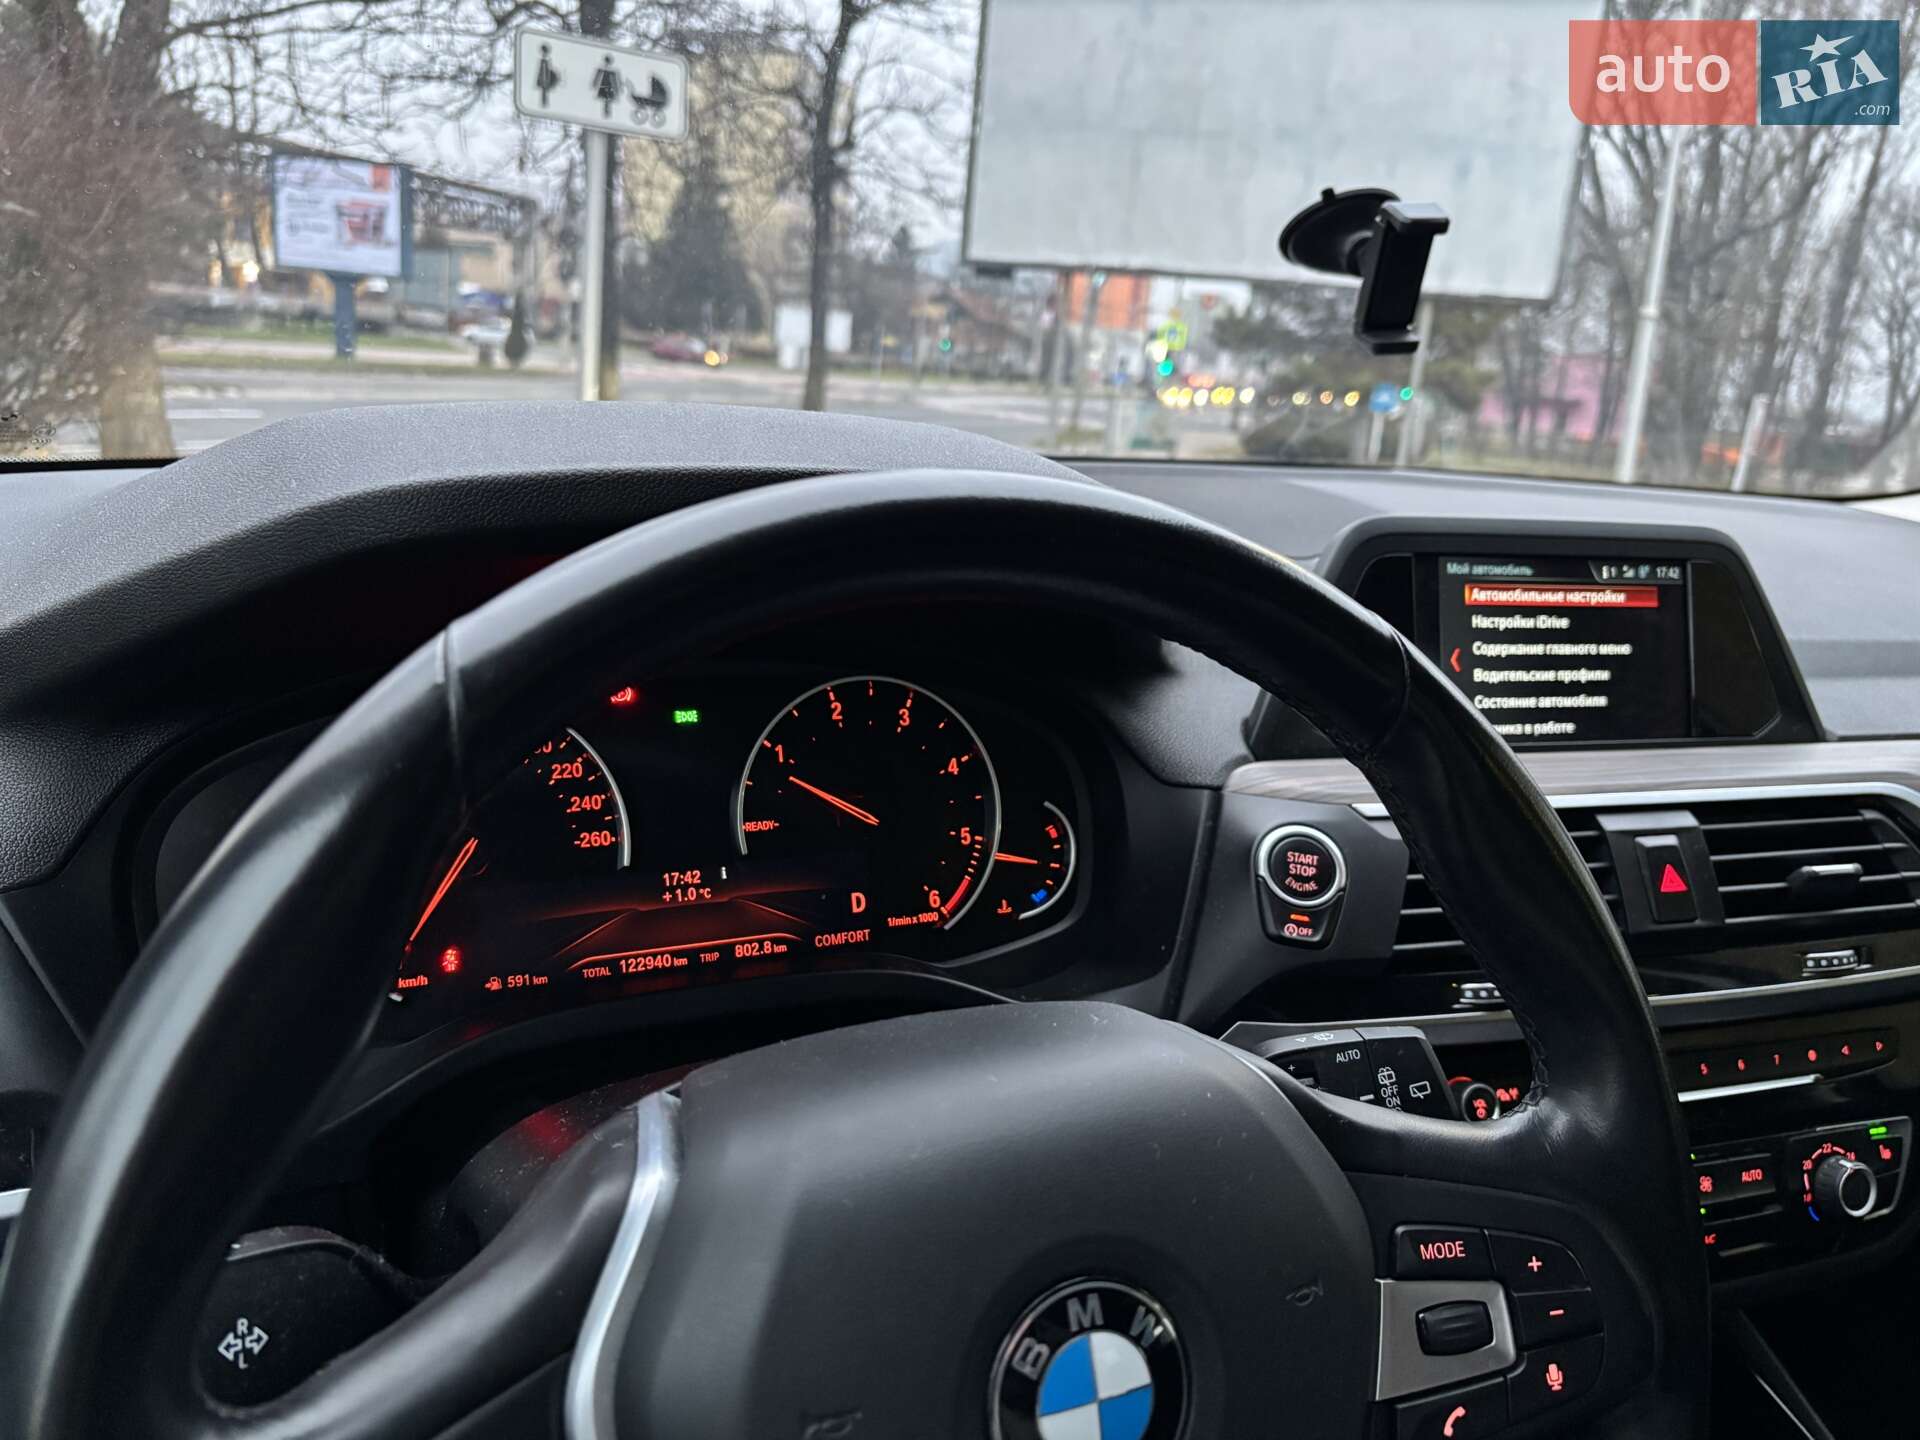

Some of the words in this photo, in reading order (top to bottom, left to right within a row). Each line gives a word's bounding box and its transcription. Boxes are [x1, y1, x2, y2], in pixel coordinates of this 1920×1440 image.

[1447, 562, 1470, 576] Мой
[1472, 564, 1533, 577] автомобиль
[1471, 588, 1564, 603] Автомобильные
[1566, 590, 1627, 604] настройки
[1471, 614, 1535, 631] Настройки
[1536, 615, 1570, 629] iDrive
[1472, 641, 1545, 658] Содержание
[1546, 643, 1598, 655] главного
[1599, 643, 1632, 655] меню
[1473, 668, 1556, 684] Водительские
[1557, 668, 1611, 684] профили
[1474, 694, 1537, 709] Состояние
[1538, 694, 1608, 708] автомобиля
[831, 702, 842, 720] 2
[899, 708, 910, 726] 3
[1534, 721, 1576, 736] работе
[775, 744, 784, 763] 1
[551, 763, 583, 779] 220
[947, 757, 959, 774] 4
[570, 795, 602, 812] 240
[745, 820, 775, 832] READY
[580, 830, 611, 848] 260
[960, 827, 971, 845] 5
[1287, 851, 1319, 865] START
[663, 870, 701, 886] 17:42
[1289, 863, 1316, 877] STOP
[1285, 876, 1319, 891] ENGINE
[851, 892, 866, 913] D
[929, 890, 941, 908] 6
[887, 915, 912, 927] 1/min
[918, 911, 939, 923] 1000
[814, 928, 871, 947] COMFORT
[1298, 926, 1313, 936] OFF
[700, 952, 720, 963] TRIP
[735, 941, 772, 957] 802.8
[774, 943, 787, 952] km
[582, 966, 611, 978] TOTAL
[619, 953, 672, 973] 122940
[673, 956, 688, 967] km
[398, 975, 429, 988] km/h
[507, 975, 531, 987] 591
[533, 975, 548, 985] km
[1336, 1049, 1361, 1063] AUTO
[1700, 1063, 1708, 1075] 5
[1380, 1084, 1398, 1098] OFF
[1385, 1096, 1401, 1107] ON
[1741, 1169, 1763, 1183] AUTO
[1420, 1241, 1466, 1260] MODE
[237, 1318, 248, 1335] R
[1012, 1292, 1166, 1381] BMW
[238, 1353, 248, 1369] L
